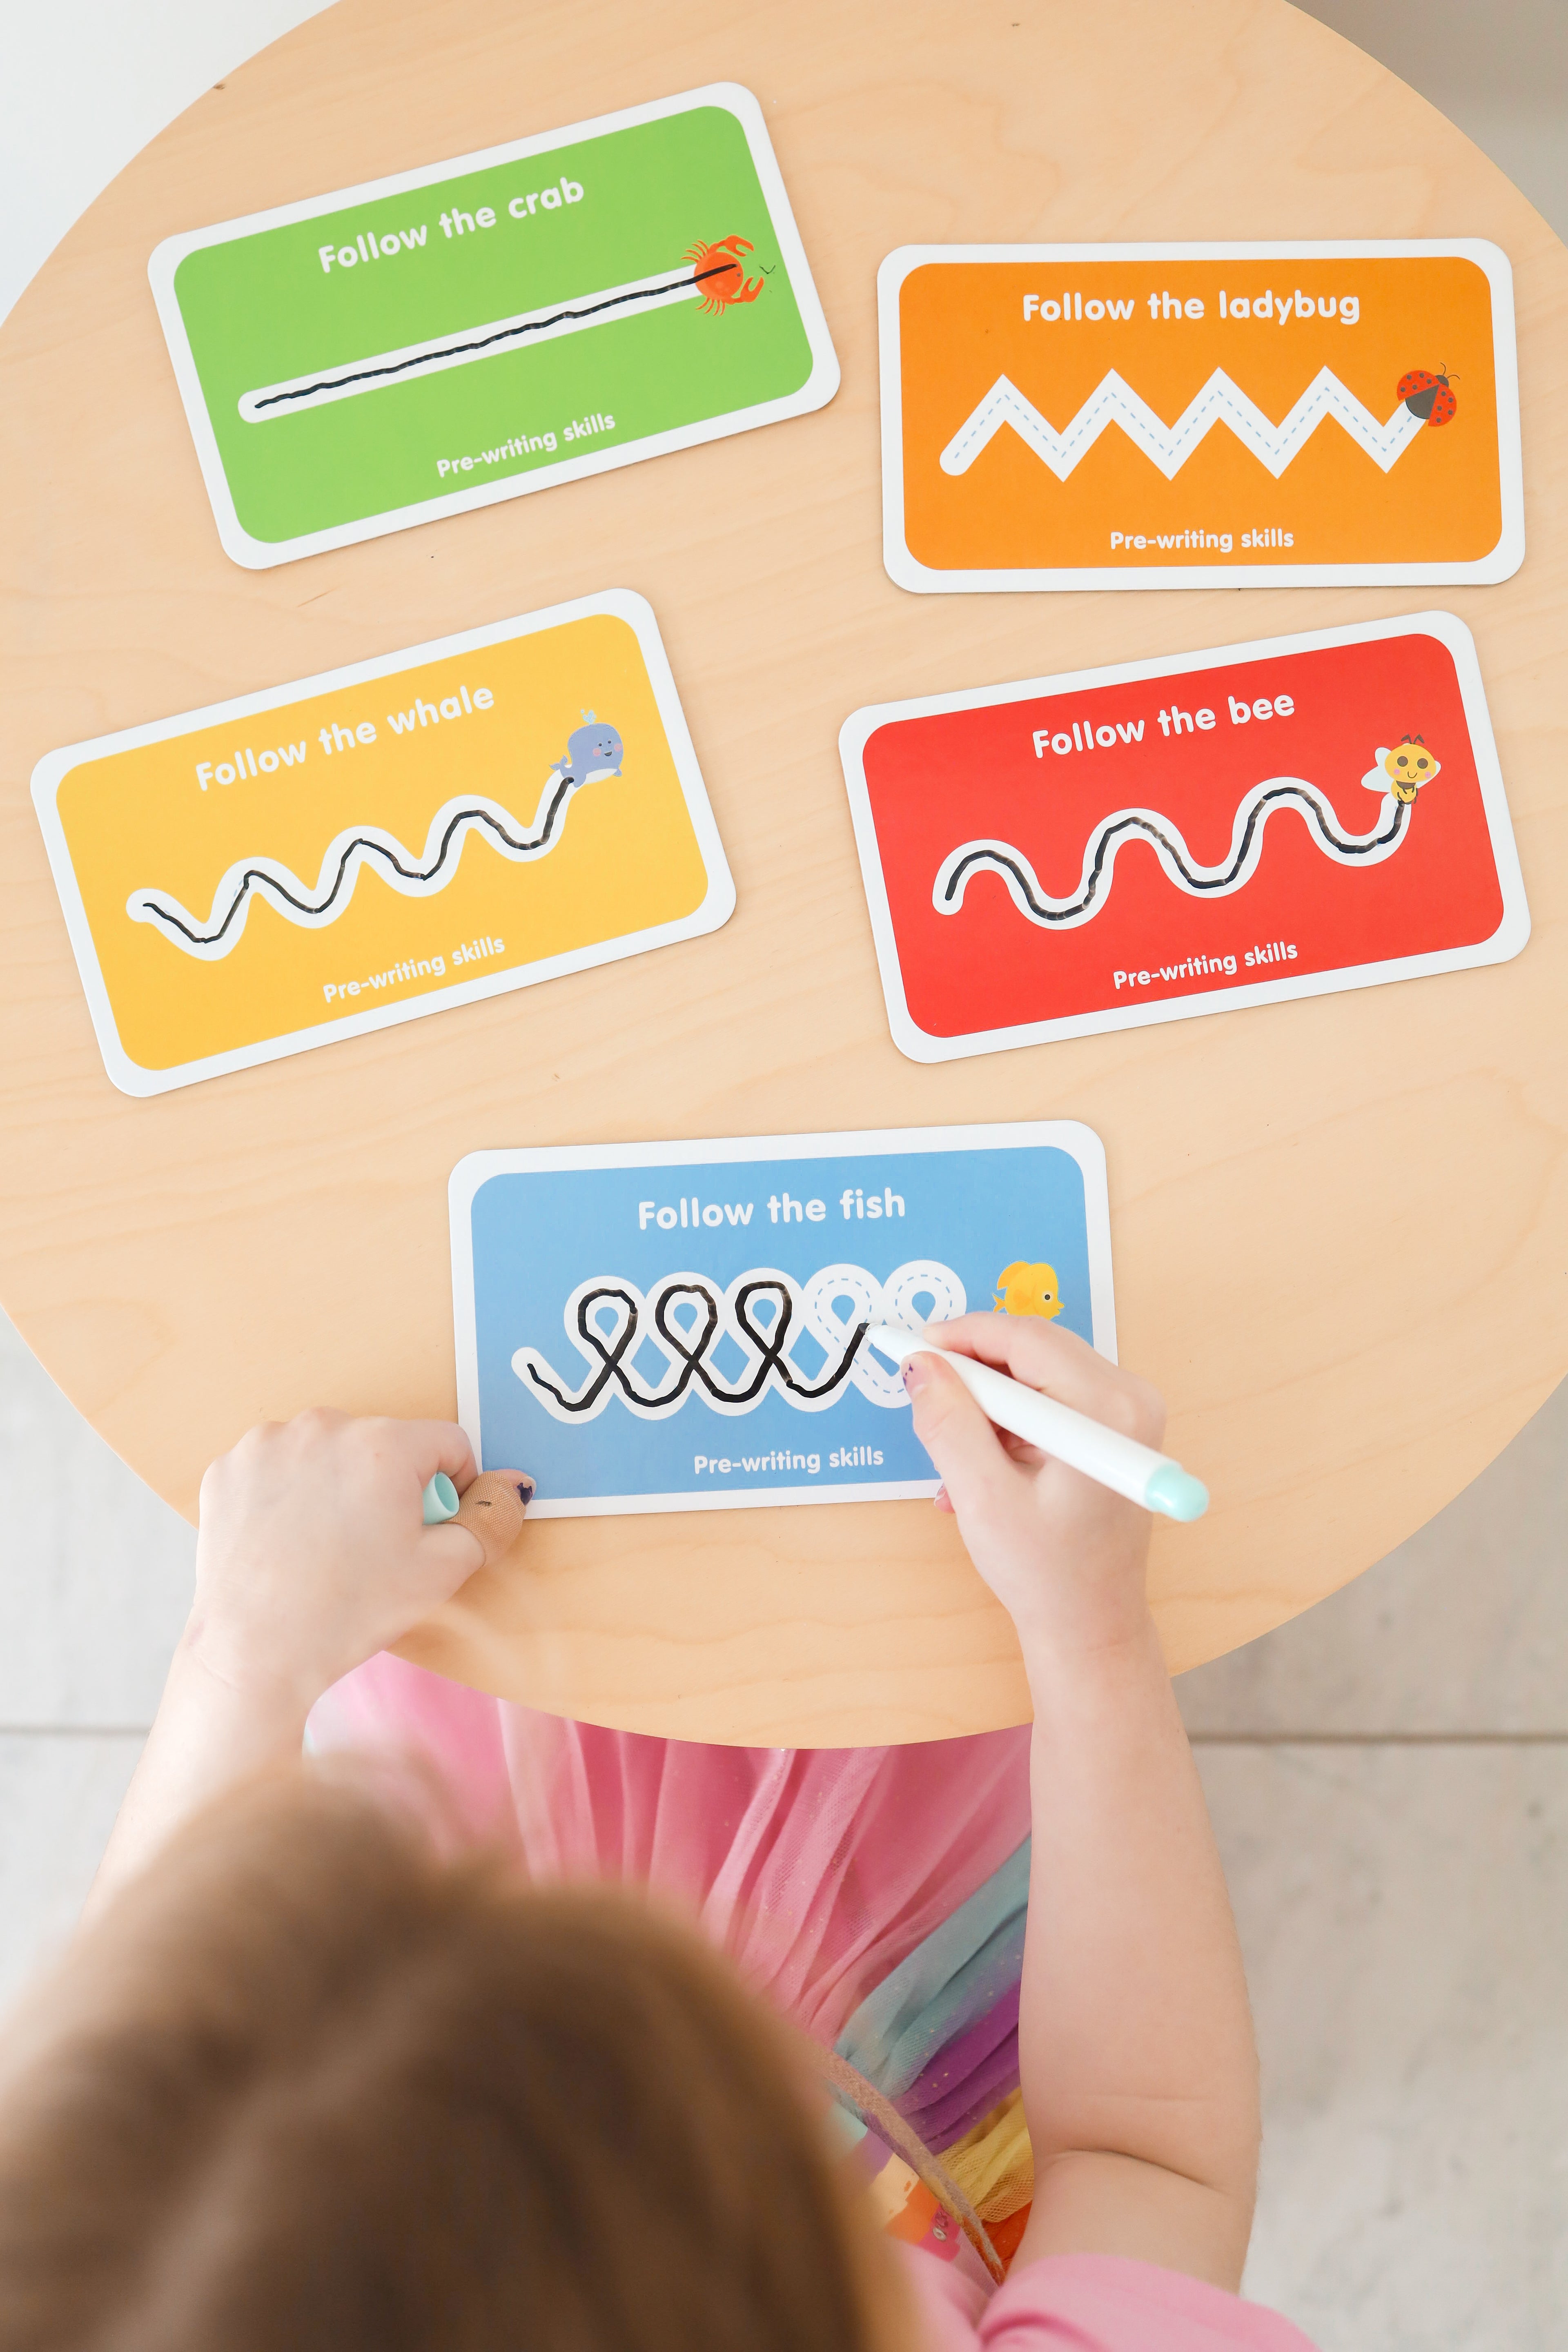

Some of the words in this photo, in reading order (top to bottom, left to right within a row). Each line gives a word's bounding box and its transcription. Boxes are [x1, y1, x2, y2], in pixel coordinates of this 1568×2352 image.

[318, 224, 428, 274] Follow
[438, 206, 497, 239] the
[508, 176, 585, 219] crab
[1022, 291, 1136, 322] Follow
[1146, 290, 1205, 320] the
[1218, 288, 1361, 326] ladybug
[436, 431, 558, 479] Pre-writing
[562, 412, 616, 442] skills
[1109, 528, 1234, 554] Pre-writing
[1240, 527, 1295, 548] skills
[195, 739, 307, 792] Follow
[317, 721, 378, 756] the
[386, 684, 495, 735] whale
[1031, 719, 1146, 759] Follow
[1156, 705, 1217, 737] the
[1227, 694, 1296, 726] bee
[322, 955, 447, 1004] Pre-writing
[451, 935, 506, 966] skills
[1112, 954, 1238, 990] Pre-writing
[1243, 940, 1298, 967] skills
[638, 1196, 755, 1231] Follow
[766, 1192, 827, 1224] the
[838, 1186, 906, 1221] fish
[693, 1449, 821, 1475] Pre-writing
[829, 1445, 884, 1468] skills
